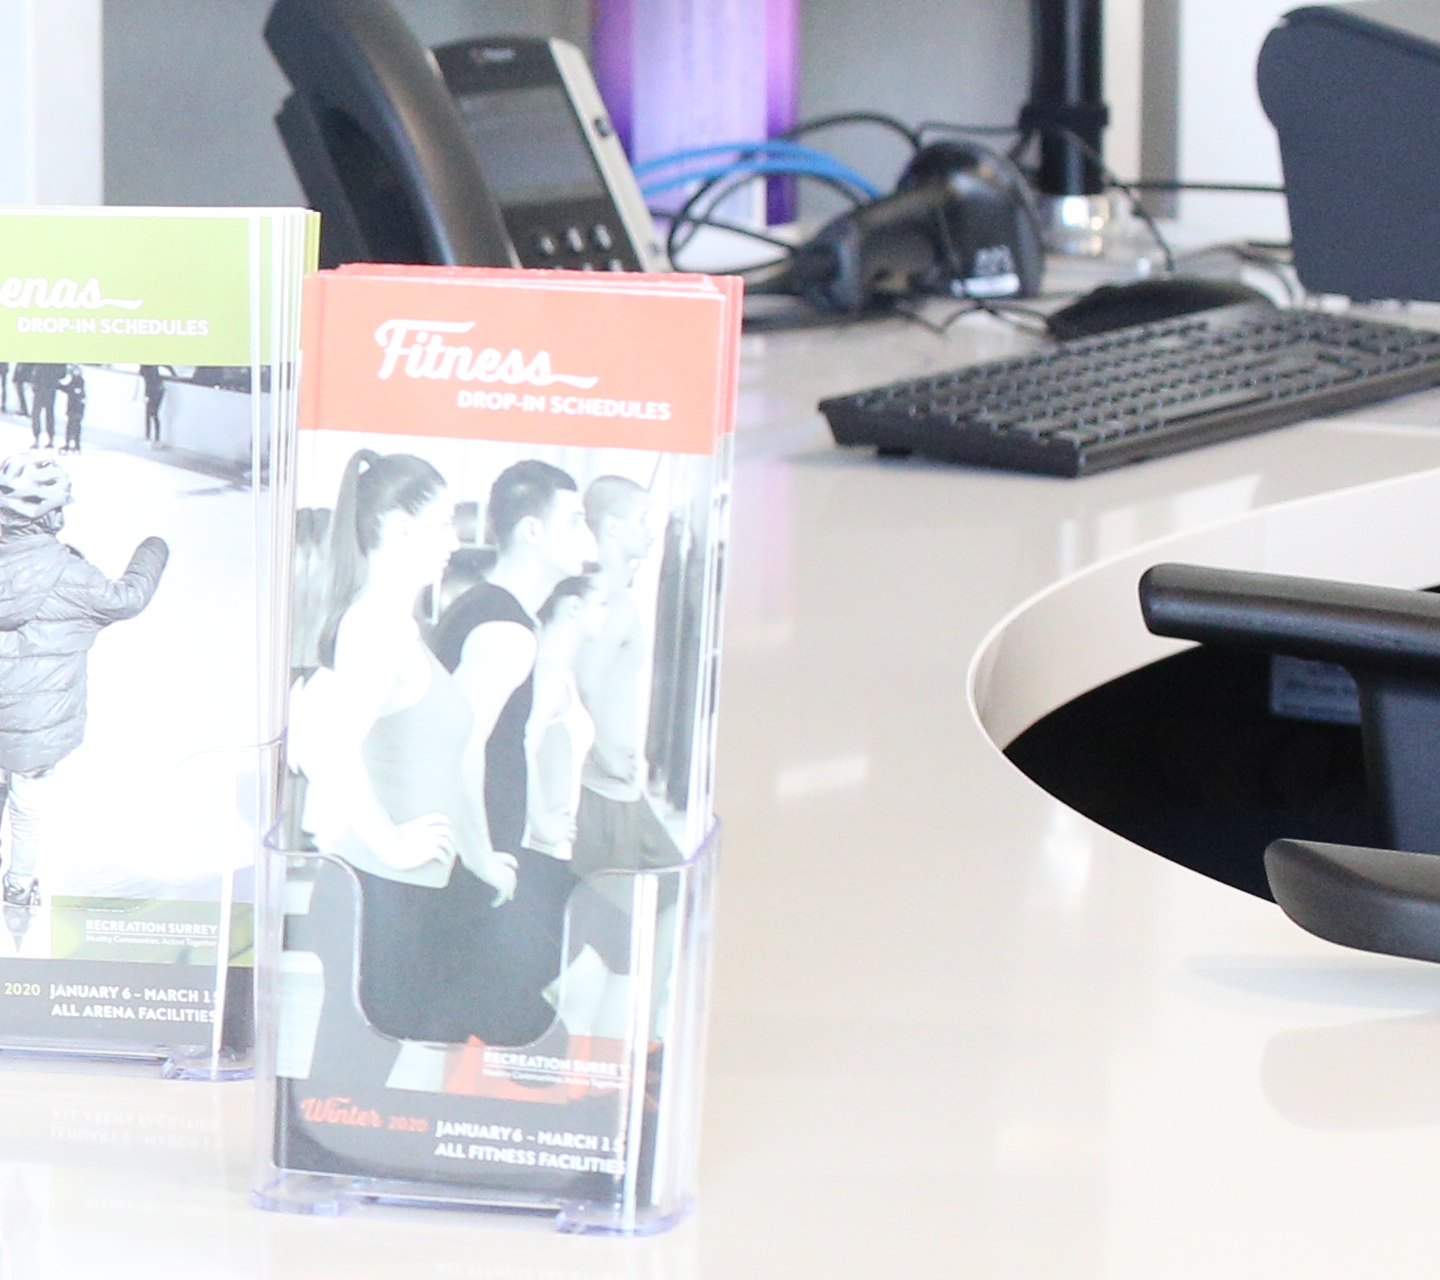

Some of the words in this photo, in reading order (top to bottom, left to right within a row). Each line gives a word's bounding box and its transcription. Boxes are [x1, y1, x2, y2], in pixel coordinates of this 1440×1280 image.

[16, 316, 97, 334] DROP-IN
[99, 317, 210, 336] SCHEDULES
[374, 318, 599, 389] Fitness
[456, 389, 546, 413] DROP-IN
[549, 394, 672, 421] SCHEDULES
[85, 919, 166, 934] RECREATION
[168, 922, 218, 936] SURREY
[4, 982, 41, 997] 2020
[48, 983, 120, 1001] JANUARY
[122, 986, 131, 1001] 6
[144, 987, 200, 1003] MARCH
[51, 1003, 80, 1017] ALL
[83, 1005, 135, 1020] ARENA
[137, 1007, 217, 1023] FACILITIES
[483, 1051, 571, 1072] RECREATION
[299, 1095, 384, 1128] Winter
[387, 1115, 429, 1132] 2020
[434, 1119, 513, 1142] JANUARY
[512, 1126, 523, 1143] 6
[538, 1130, 598, 1150] MARCH
[434, 1142, 468, 1159] ALL
[468, 1144, 537, 1166] FITNESS
[538, 1151, 627, 1174] FACILITIES
